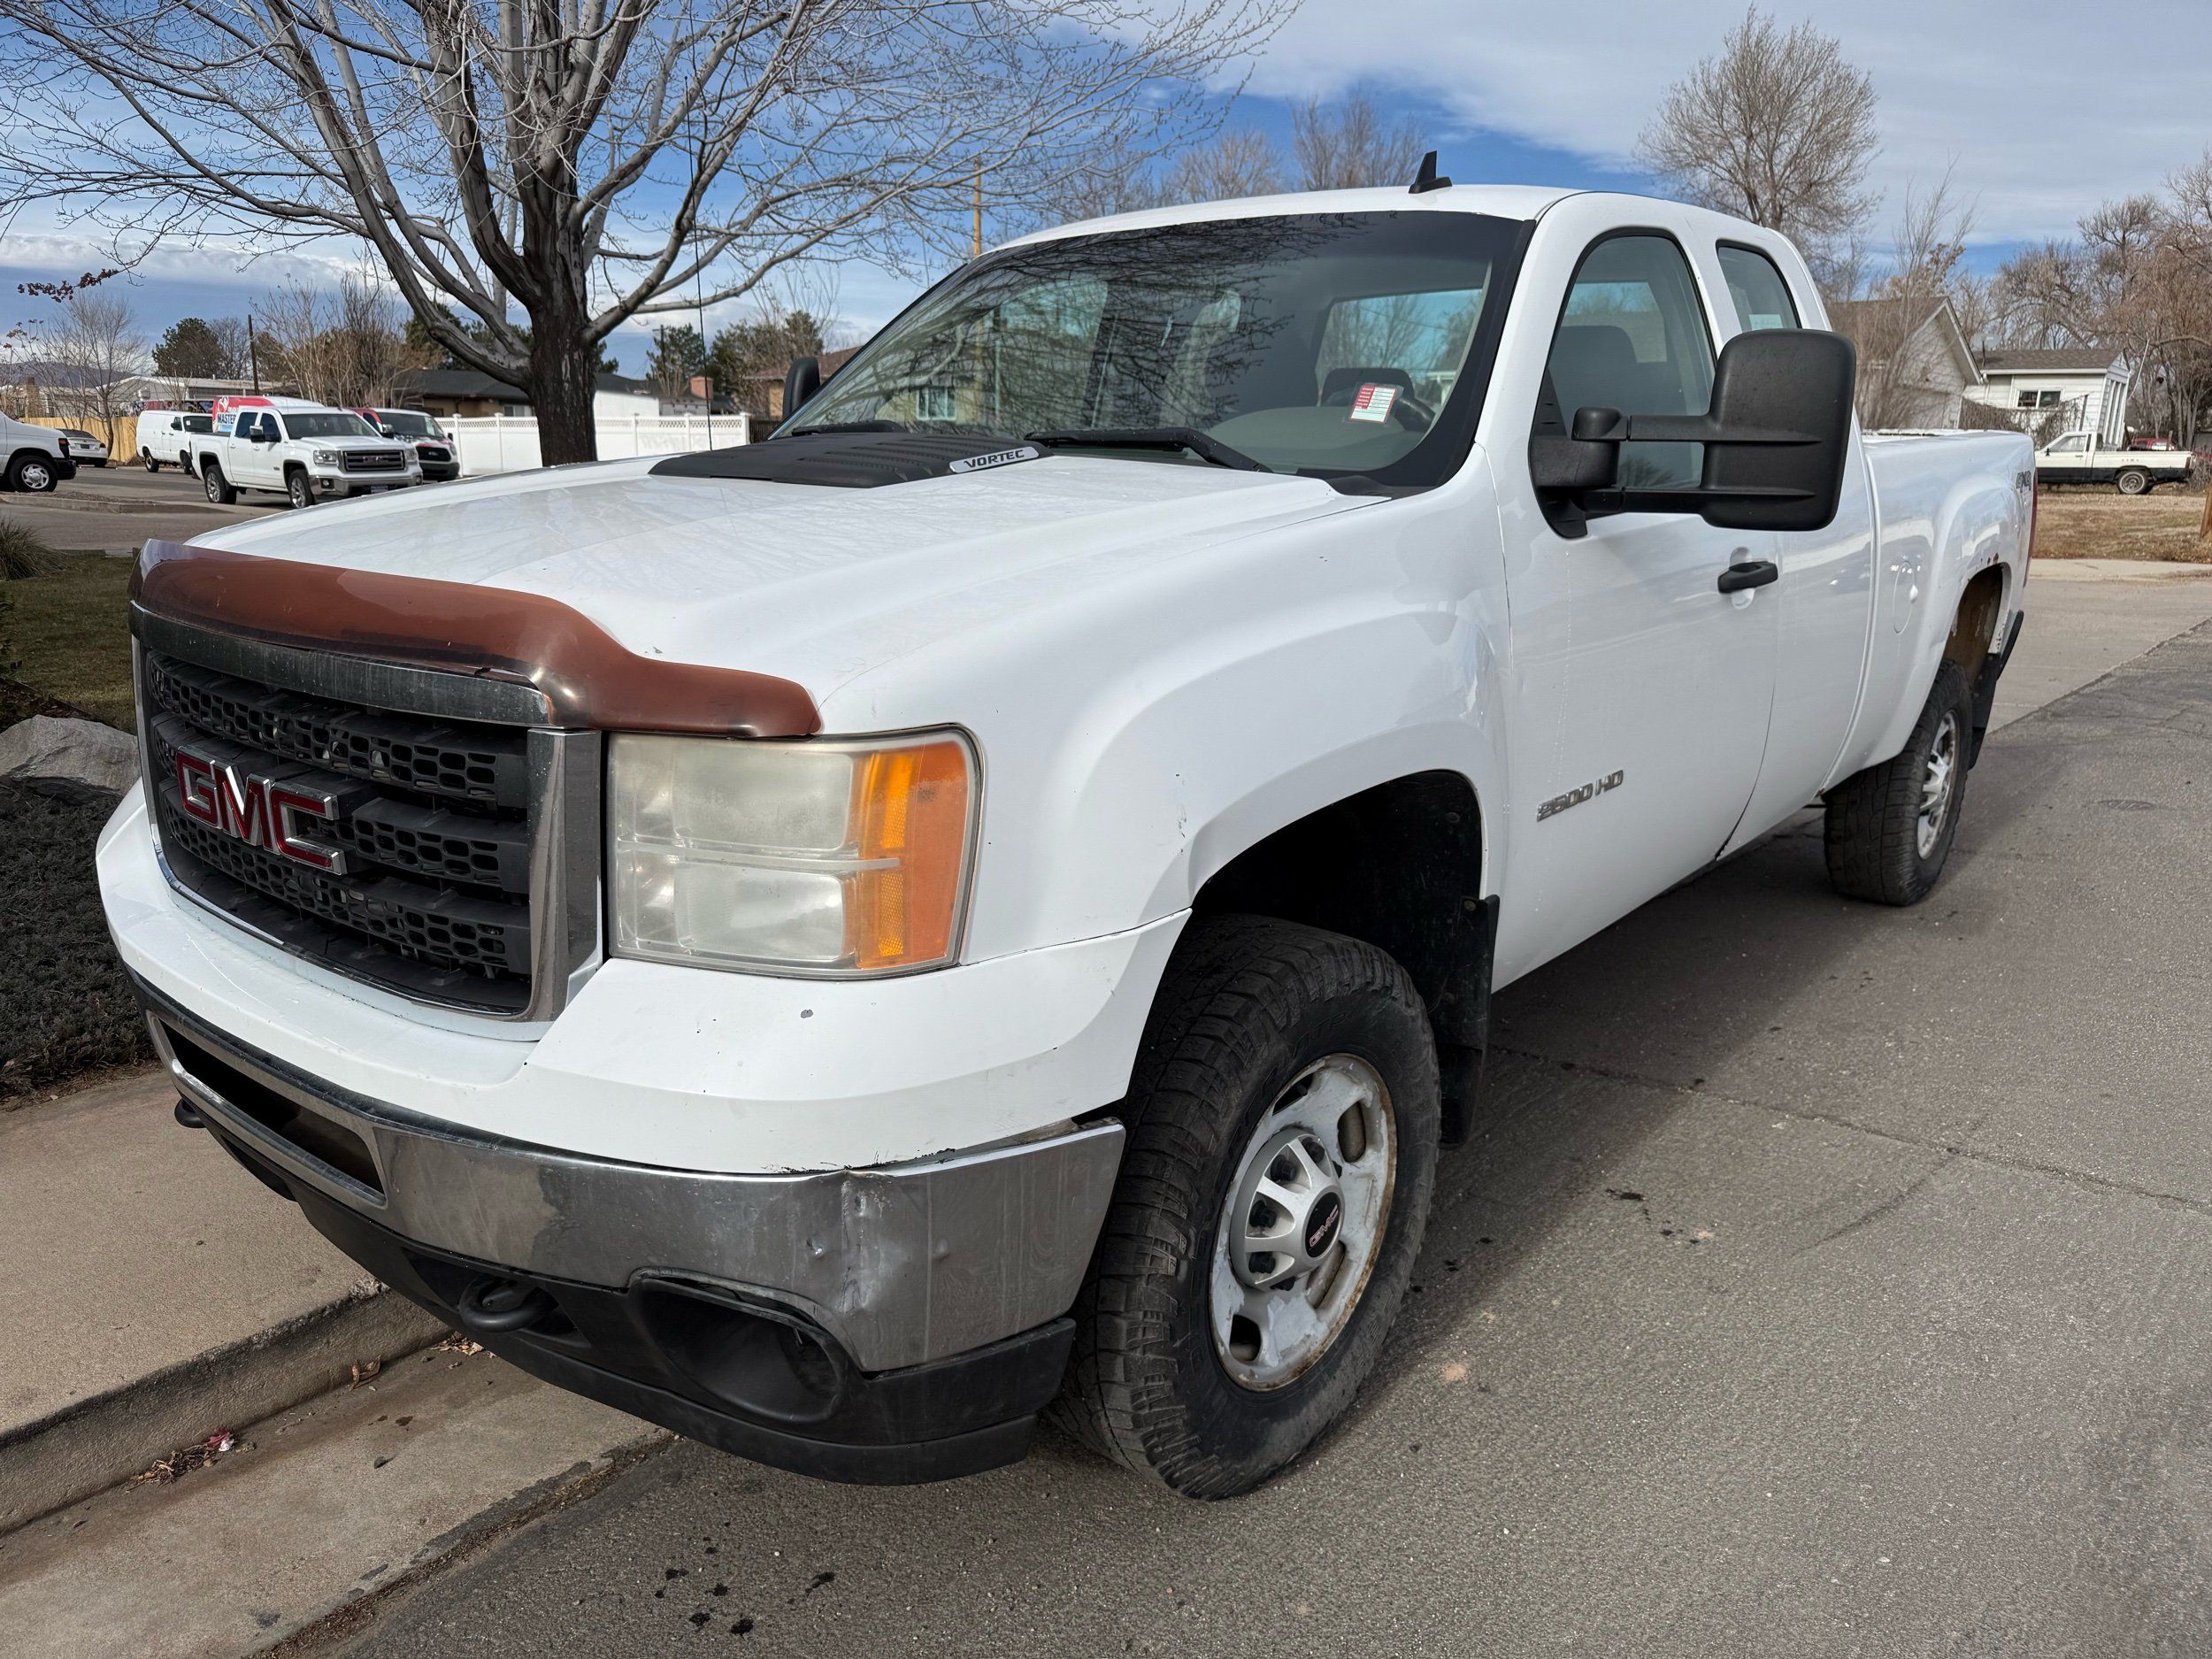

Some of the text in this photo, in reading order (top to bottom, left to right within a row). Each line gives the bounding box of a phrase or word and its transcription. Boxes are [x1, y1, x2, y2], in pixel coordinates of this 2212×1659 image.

[963, 449, 1025, 468] VORTEC
[176, 745, 347, 876] GMC
[1537, 770, 1624, 822] 2500 HD
[1309, 1203, 1339, 1248] GMC
